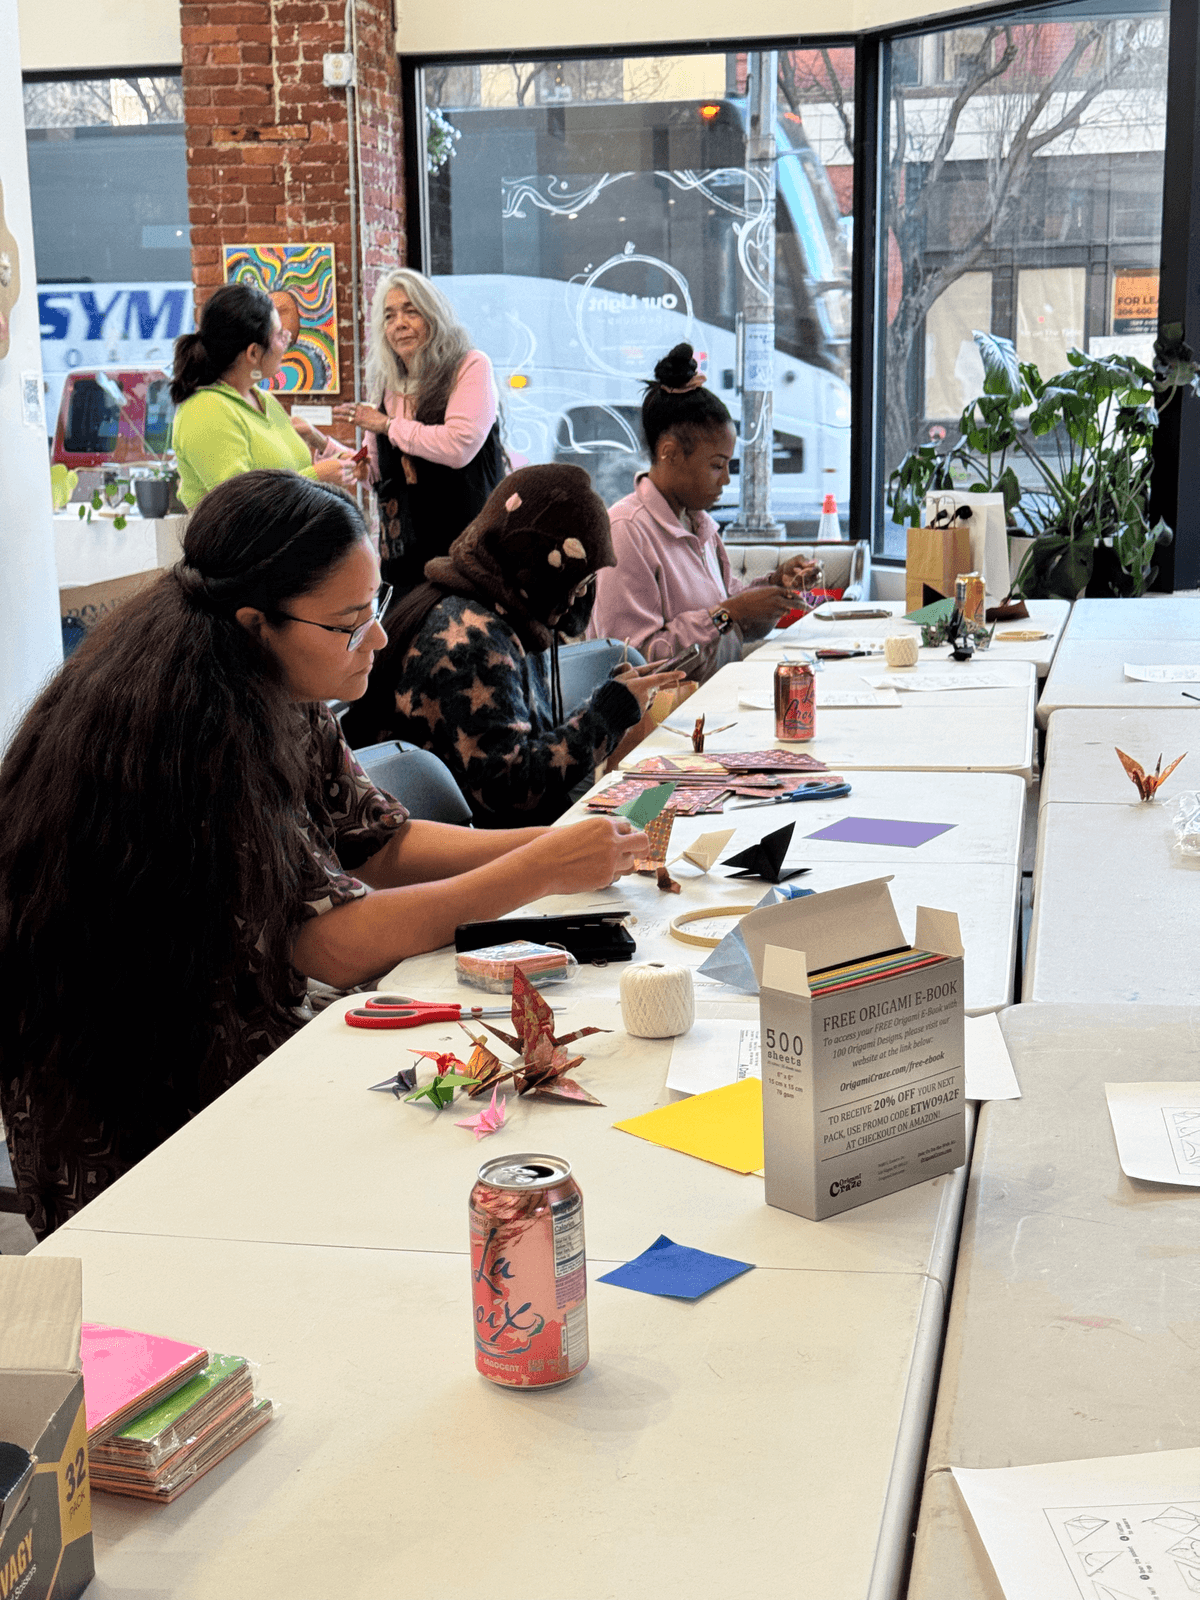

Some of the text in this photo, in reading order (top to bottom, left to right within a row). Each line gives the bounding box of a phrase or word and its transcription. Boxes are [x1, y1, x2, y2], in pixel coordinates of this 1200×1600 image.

[1118, 296, 1140, 305] FOR
[823, 980, 958, 1032] FREE ORIGAMI E-BOOK
[823, 999, 958, 1047] To access your FREE Origami E-Book with
[766, 1028, 803, 1056] 500
[833, 1049, 846, 1059] 100
[847, 1039, 876, 1055] Origami
[904, 1025, 924, 1040] please
[925, 1020, 938, 1031] visit
[938, 1016, 950, 1026] our
[852, 1036, 934, 1067] website at the link below:
[767, 1051, 801, 1066] sheets
[840, 1050, 945, 1091] OrigamiCraze.com/free-ebook
[828, 1076, 955, 1126] TO RECEIVE 20% OFF YOUR NEXT
[823, 1131, 846, 1144] PACK,
[846, 1124, 861, 1136] USE
[862, 1114, 889, 1131] PROMO
[890, 1108, 910, 1122] CODE
[845, 1110, 941, 1151] AT CHECKOUT ON AMAZON!
[829, 1179, 862, 1198] Craze
[474, 1227, 515, 1296] La
[65, 1446, 86, 1502] 32
[68, 1487, 86, 1521] PACK
